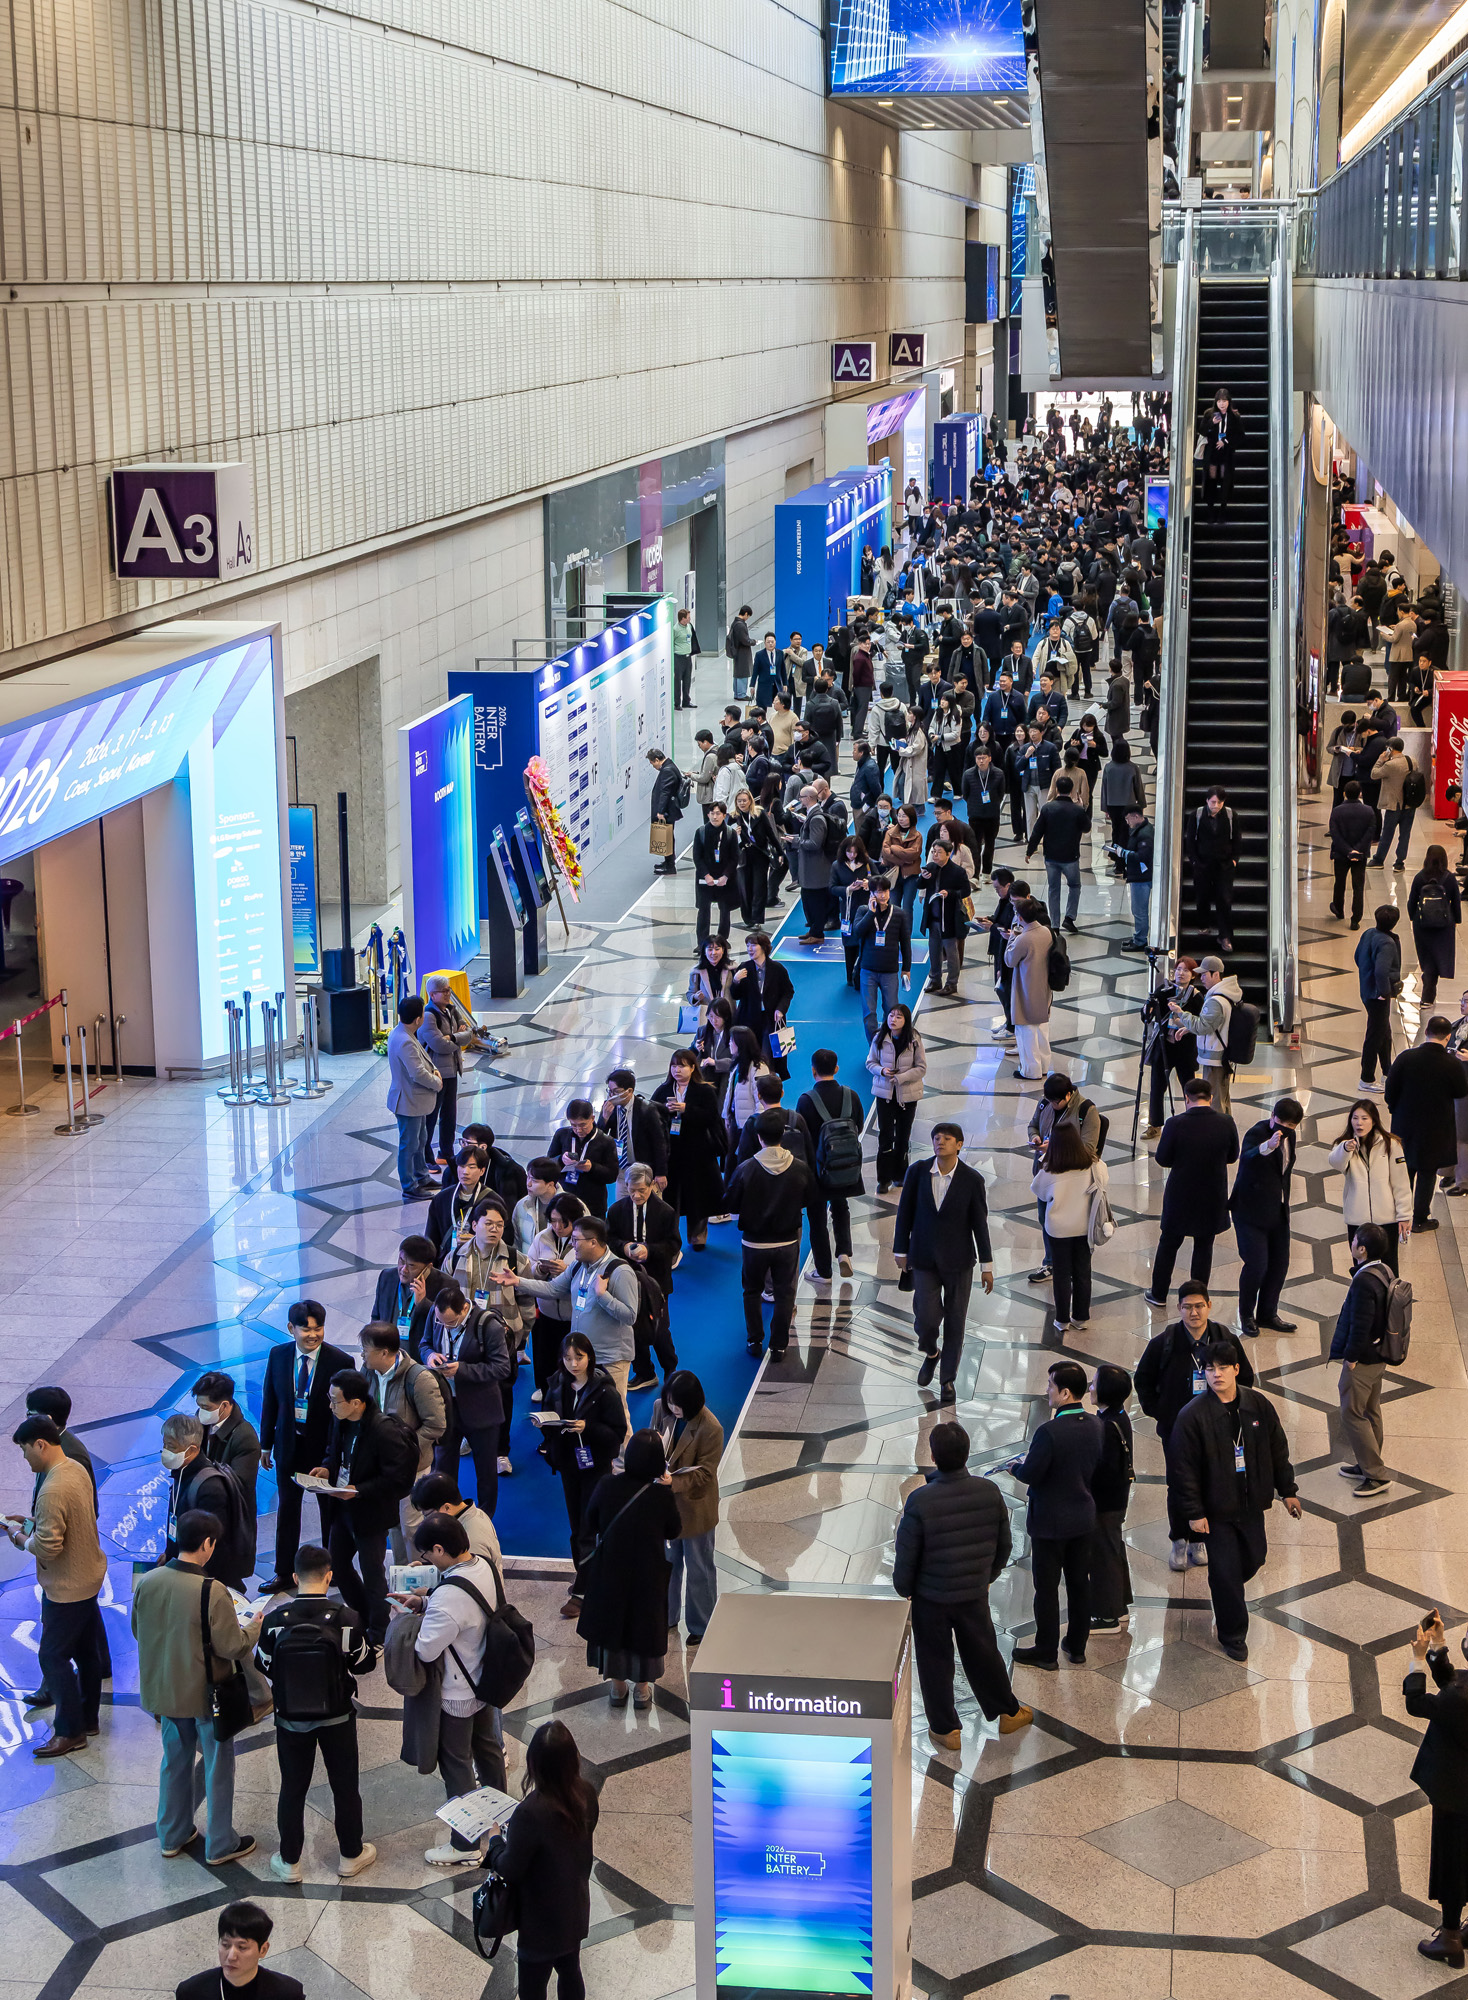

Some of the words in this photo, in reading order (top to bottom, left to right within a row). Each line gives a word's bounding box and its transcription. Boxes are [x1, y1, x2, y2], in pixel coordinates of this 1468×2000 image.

[894, 338, 921, 362] A1
[836, 349, 870, 377] A2
[122, 488, 215, 564] A3
[226, 557, 236, 571] Hall
[236, 520, 252, 568] A3
[648, 536, 663, 568] coex
[486, 706, 498, 740] INTER
[498, 706, 507, 727] 2026
[474, 706, 486, 754] BATTERY
[218, 811, 255, 825] Sponsors
[226, 874, 249, 887] posco
[220, 896, 232, 907] LS
[748, 1691, 862, 1715] information
[765, 1844, 785, 1853] 2026
[765, 1853, 797, 1864] INTER
[765, 1863, 811, 1875] BATTERY
